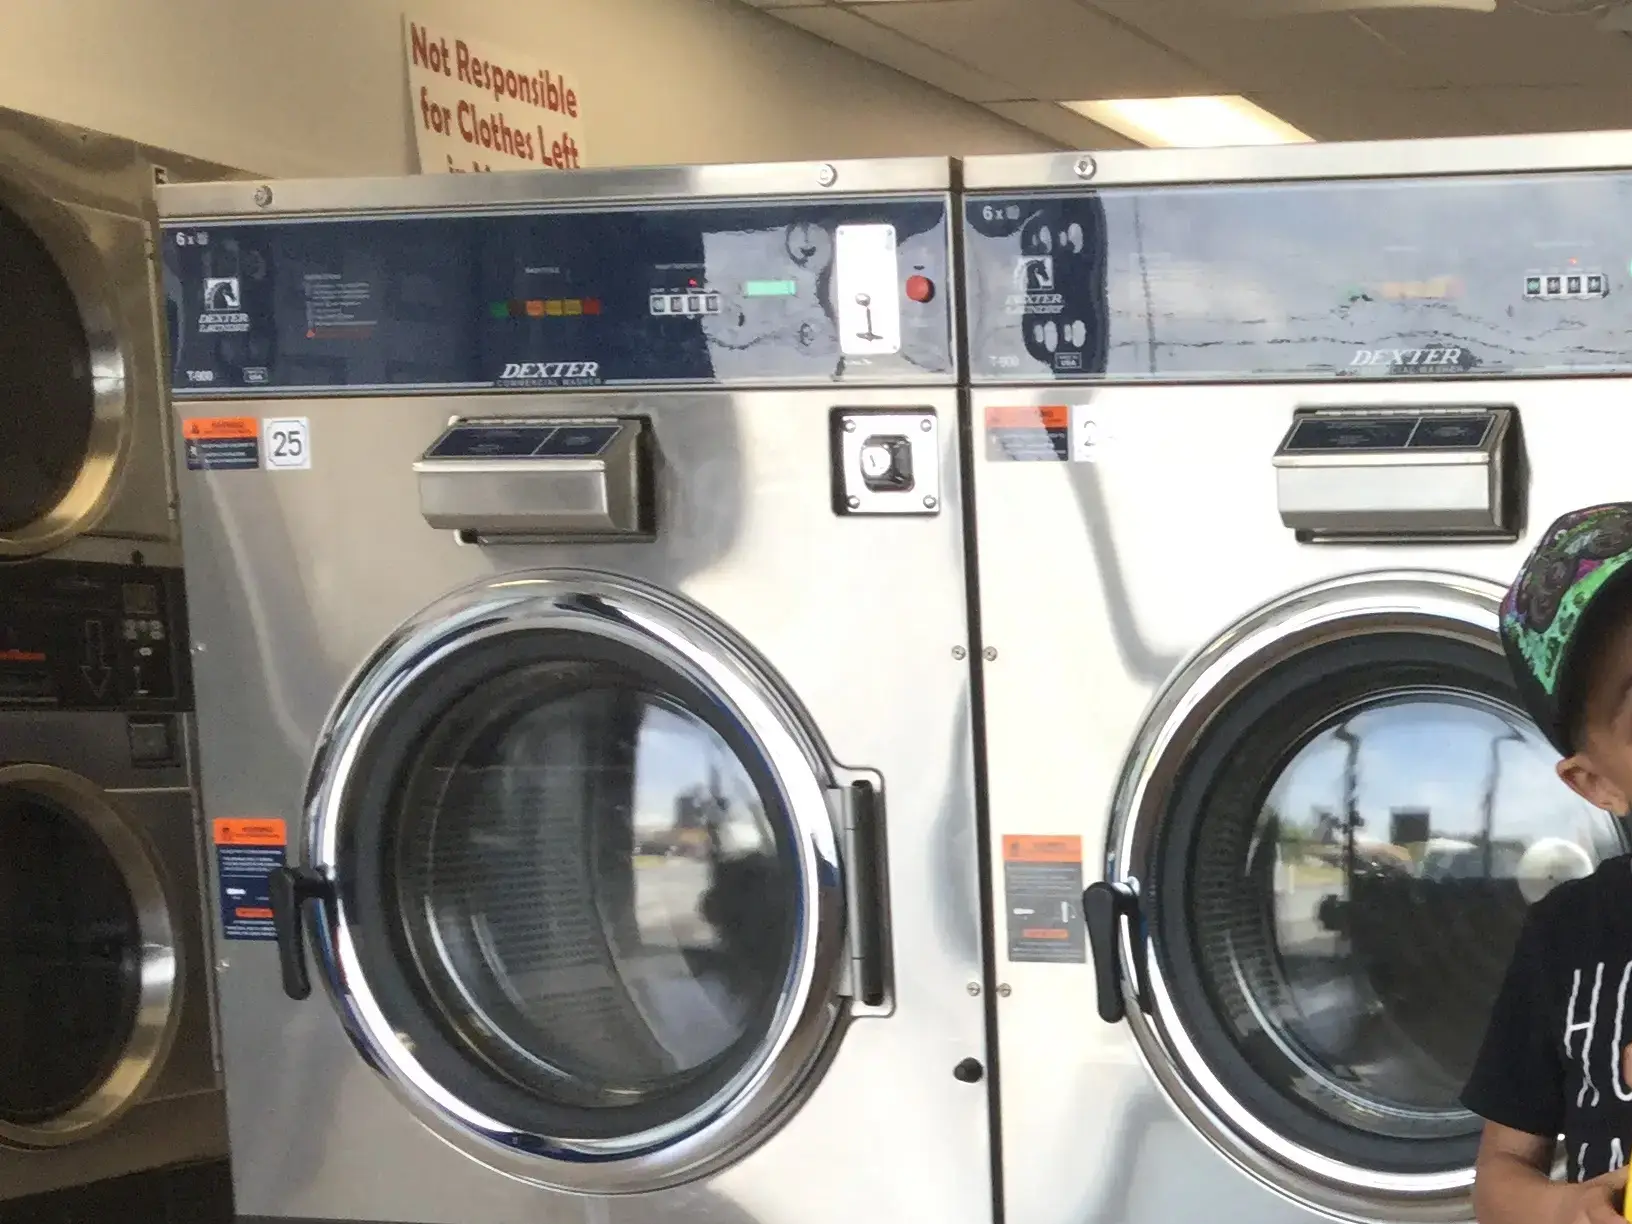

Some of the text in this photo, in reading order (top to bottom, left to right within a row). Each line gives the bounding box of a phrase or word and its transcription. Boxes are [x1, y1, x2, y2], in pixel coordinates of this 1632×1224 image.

[410, 22, 578, 118] Not Responsible
[420, 86, 580, 170] for Clothes Left
[982, 205, 993, 221] 6
[175, 231, 186, 247] 6
[198, 313, 250, 323] DEXTER
[1349, 348, 1462, 366] DEXTER
[499, 361, 600, 379] DEXTER
[272, 430, 302, 457] 25
